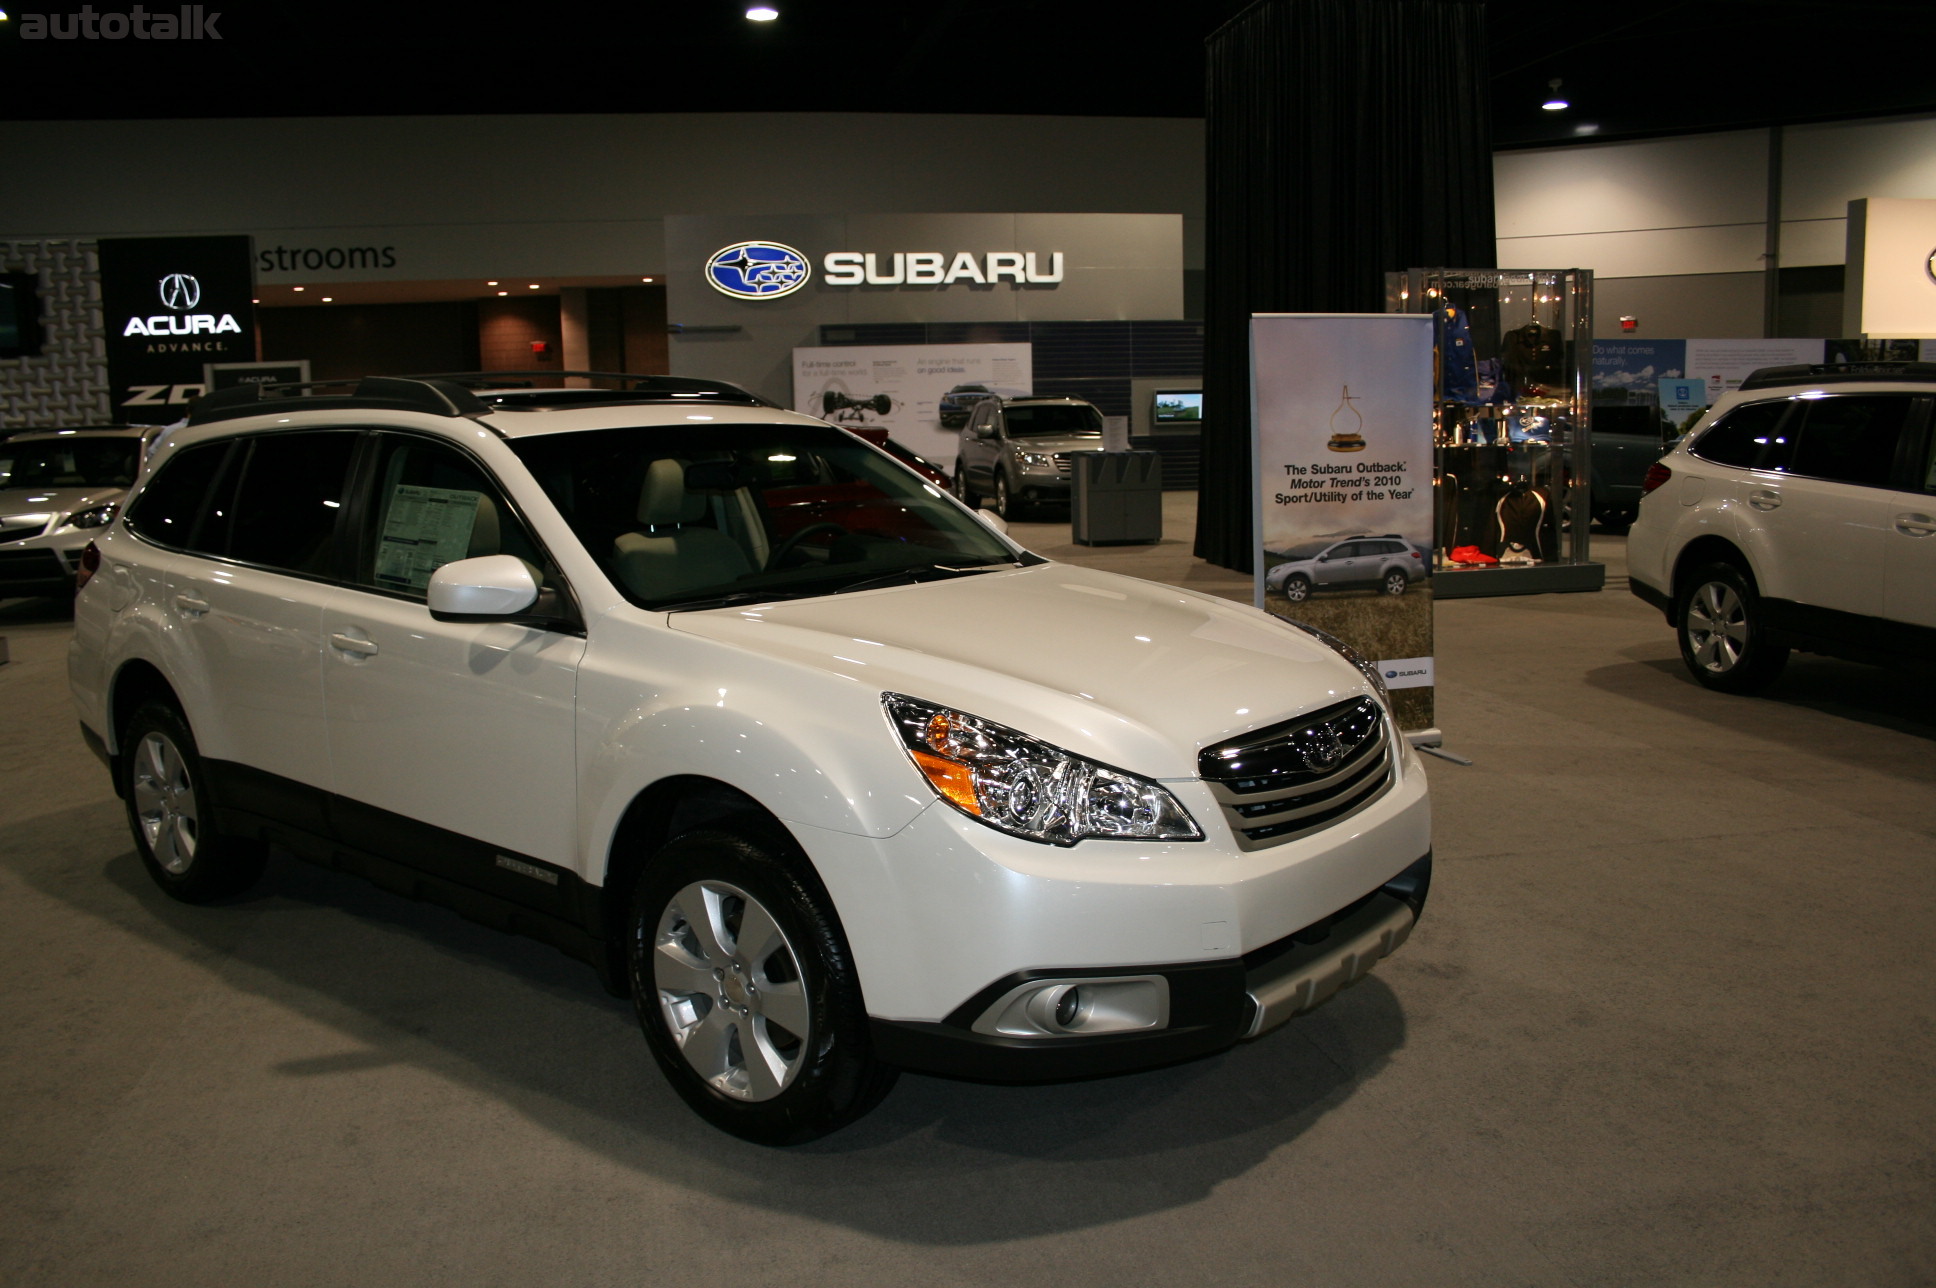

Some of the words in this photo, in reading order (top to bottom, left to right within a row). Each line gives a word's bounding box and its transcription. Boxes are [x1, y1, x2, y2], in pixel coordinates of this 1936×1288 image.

[255, 245, 397, 272] strooms
[823, 251, 1064, 286] SUBARU
[123, 313, 242, 337] ACURA
[146, 341, 229, 354] ADVANCE.
[1592, 344, 1605, 355] Do
[1606, 345, 1626, 355] what
[1627, 346, 1655, 355] comes
[244, 375, 278, 384] ACURA
[120, 383, 207, 407] ZD
[1284, 464, 1307, 476] The
[1310, 463, 1353, 475] Subaru
[1290, 478, 1326, 490] Motor
[1329, 476, 1371, 488] Trend's
[1373, 475, 1402, 487] 2010
[1274, 491, 1348, 506] Sport/Utility
[1352, 490, 1364, 501] of
[1366, 490, 1385, 501] the
[1399, 669, 1427, 677] SUBARU
